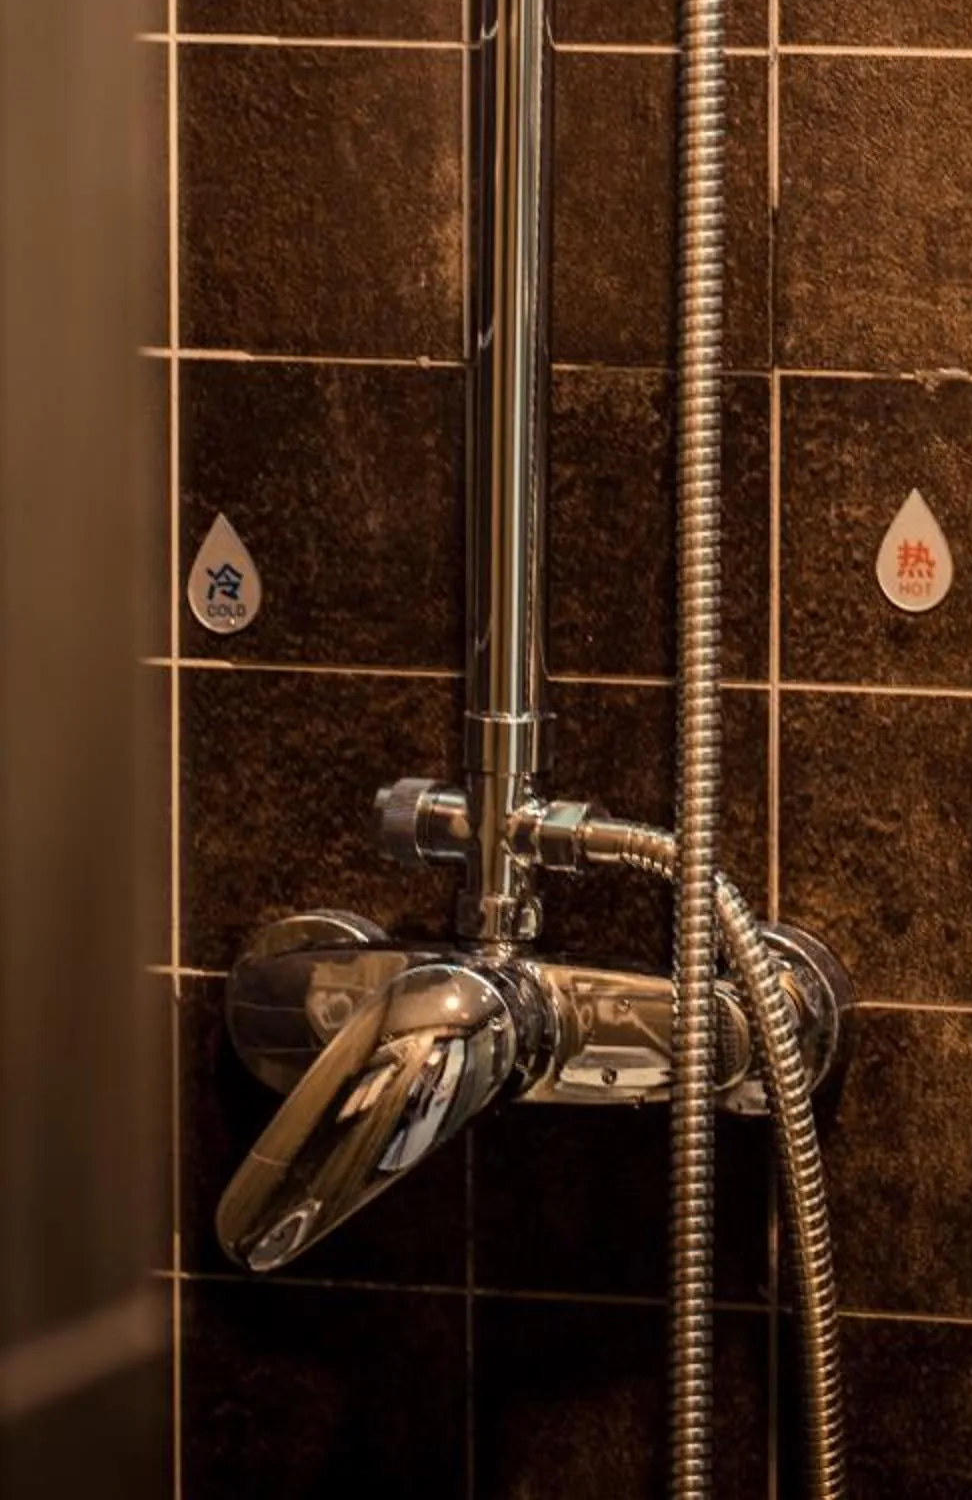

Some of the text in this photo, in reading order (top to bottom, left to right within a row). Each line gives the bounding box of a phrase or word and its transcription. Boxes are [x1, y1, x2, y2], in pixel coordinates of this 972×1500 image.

[898, 538, 936, 579] 热
[206, 563, 244, 601] 冷
[900, 582, 932, 597] HOT
[207, 604, 246, 618] COLD
